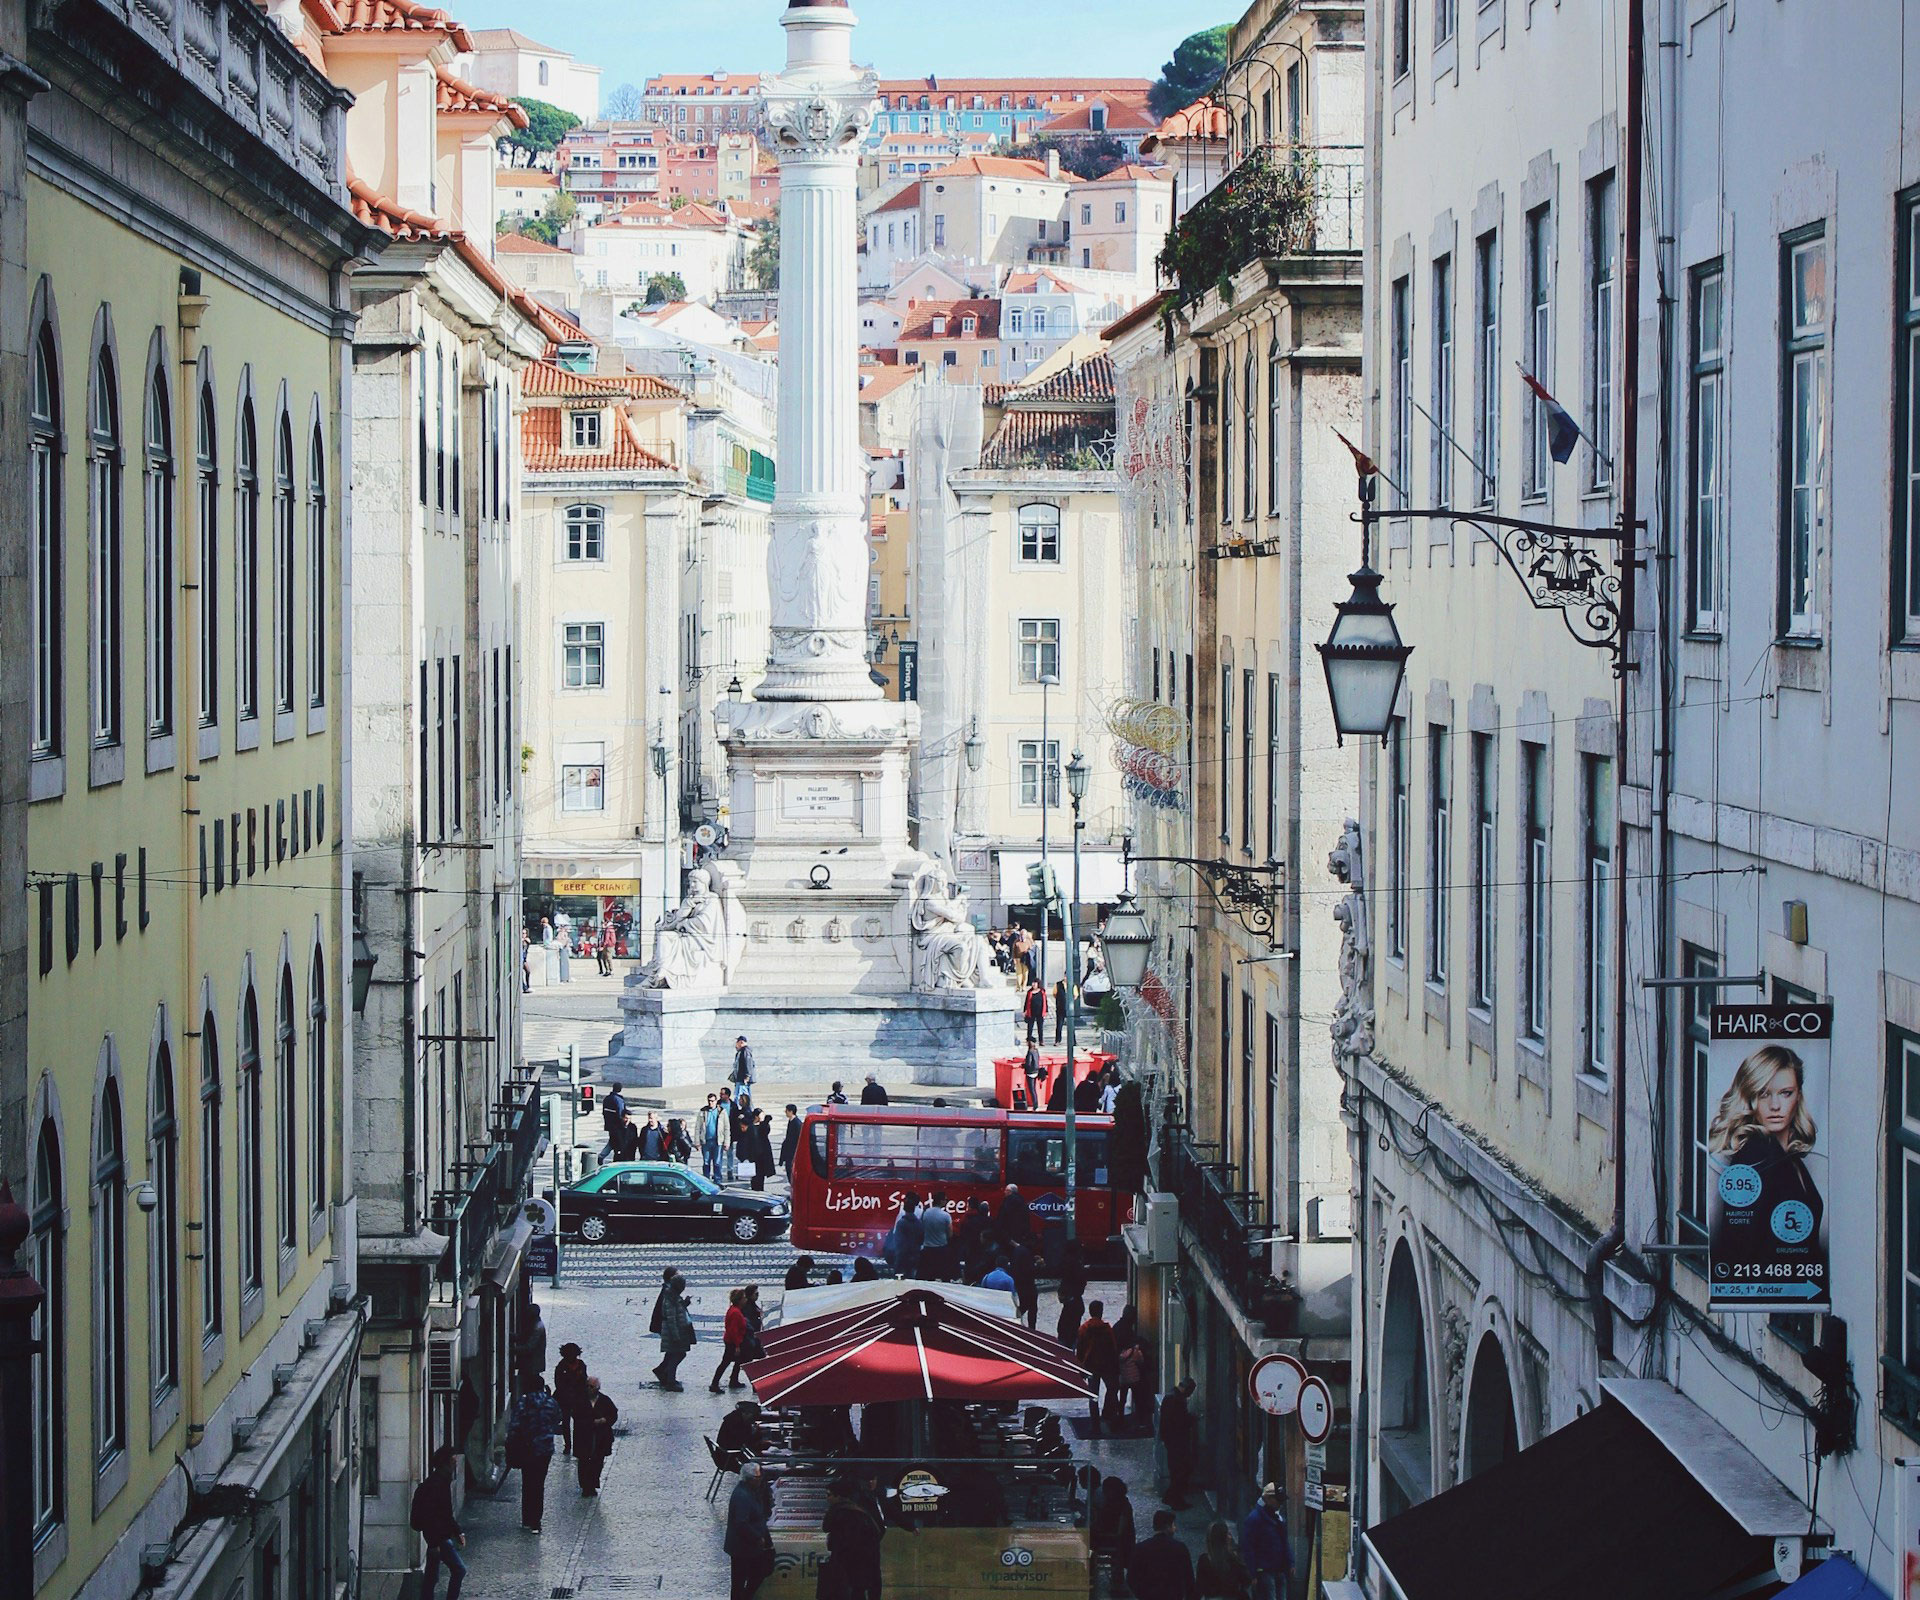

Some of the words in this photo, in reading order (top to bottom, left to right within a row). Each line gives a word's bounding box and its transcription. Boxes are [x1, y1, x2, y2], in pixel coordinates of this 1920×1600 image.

[904, 655, 914, 689] Vouga
[39, 846, 150, 977] HOTEL
[200, 783, 325, 900] AMERICANO
[1717, 1013, 1768, 1034] HAIR
[1783, 1012, 1822, 1034] CO
[825, 1188, 881, 1211] Lisbon
[1783, 1210, 1803, 1233] 5€
[1733, 1263, 1761, 1277] 213
[1764, 1263, 1792, 1277] 468
[1796, 1263, 1824, 1277] 268
[1756, 1283, 1784, 1294] Andar
[901, 1503, 912, 1512] DO
[913, 1503, 938, 1512] ROSSIO
[980, 1569, 1049, 1584] tripadvisor
